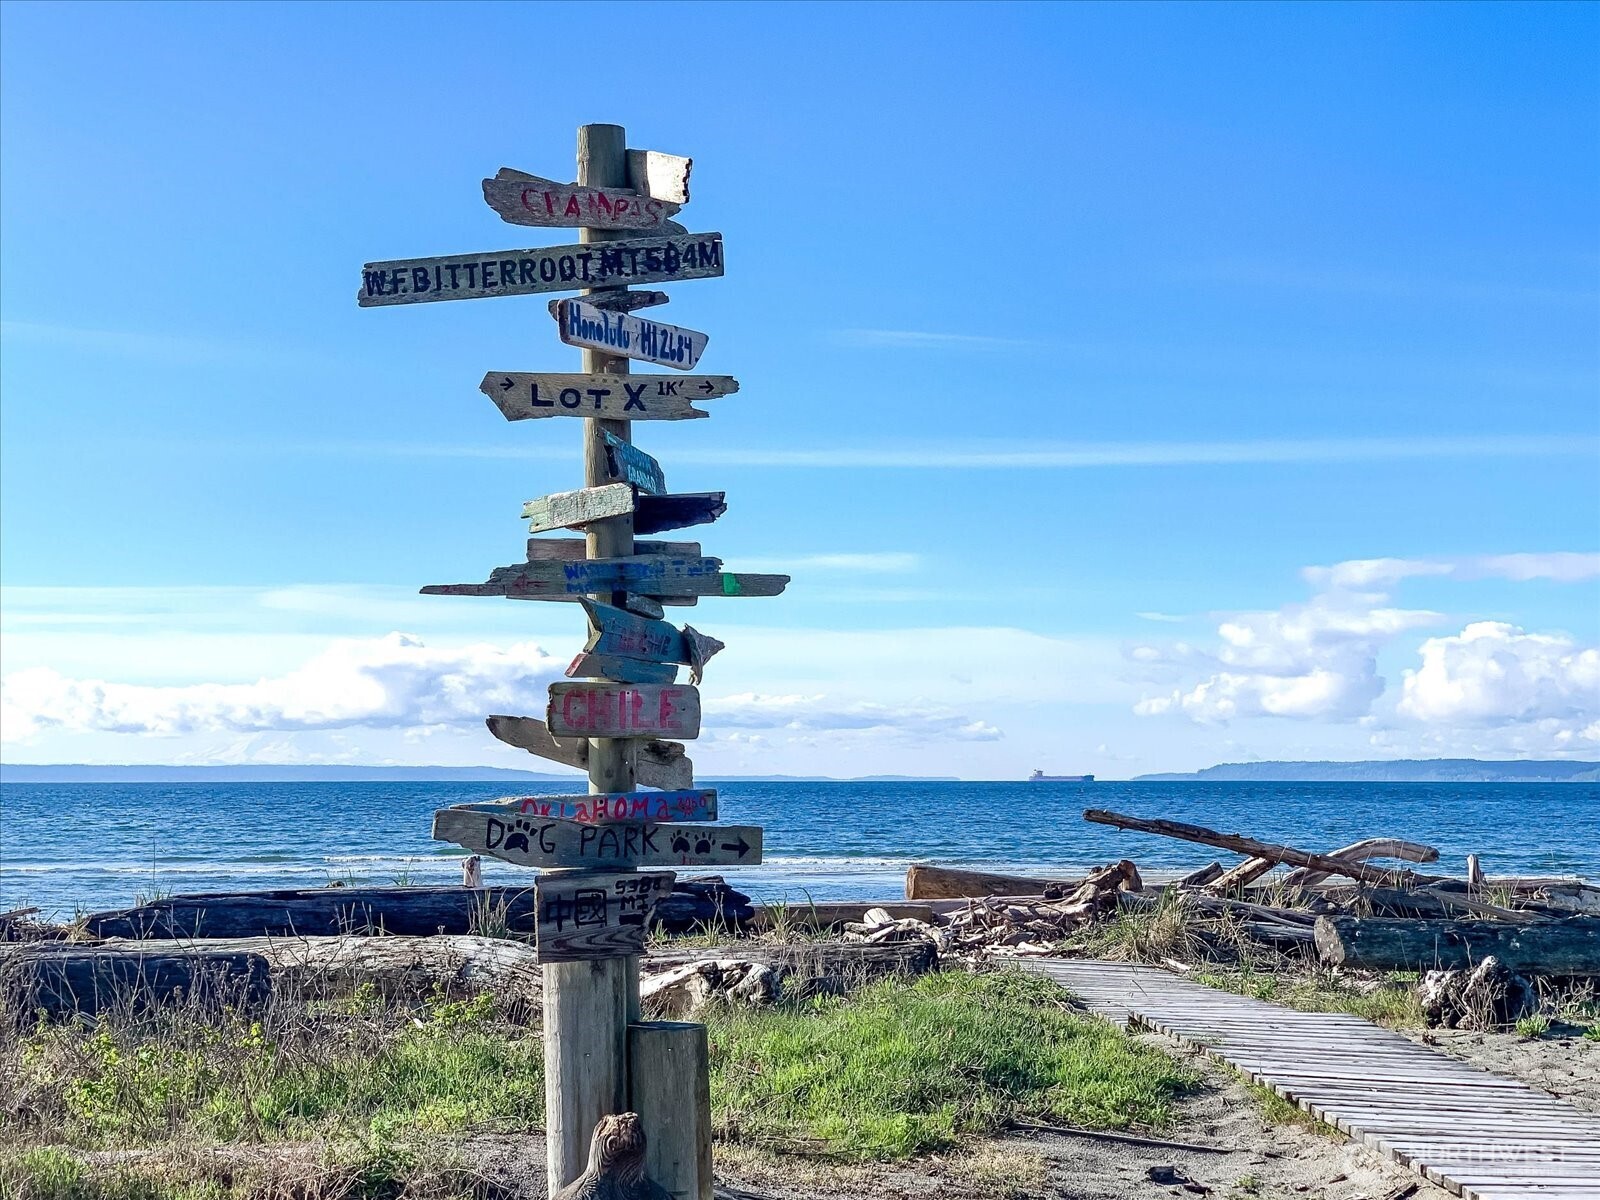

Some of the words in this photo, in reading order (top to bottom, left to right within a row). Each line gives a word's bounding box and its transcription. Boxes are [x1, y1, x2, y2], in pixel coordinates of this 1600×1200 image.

[569, 302, 630, 349] Honolulu
[641, 321, 658, 358] HI
[531, 383, 611, 409] LOT
[623, 383, 648, 411] X
[563, 688, 683, 730] CHILE
[580, 825, 660, 858] PARK
